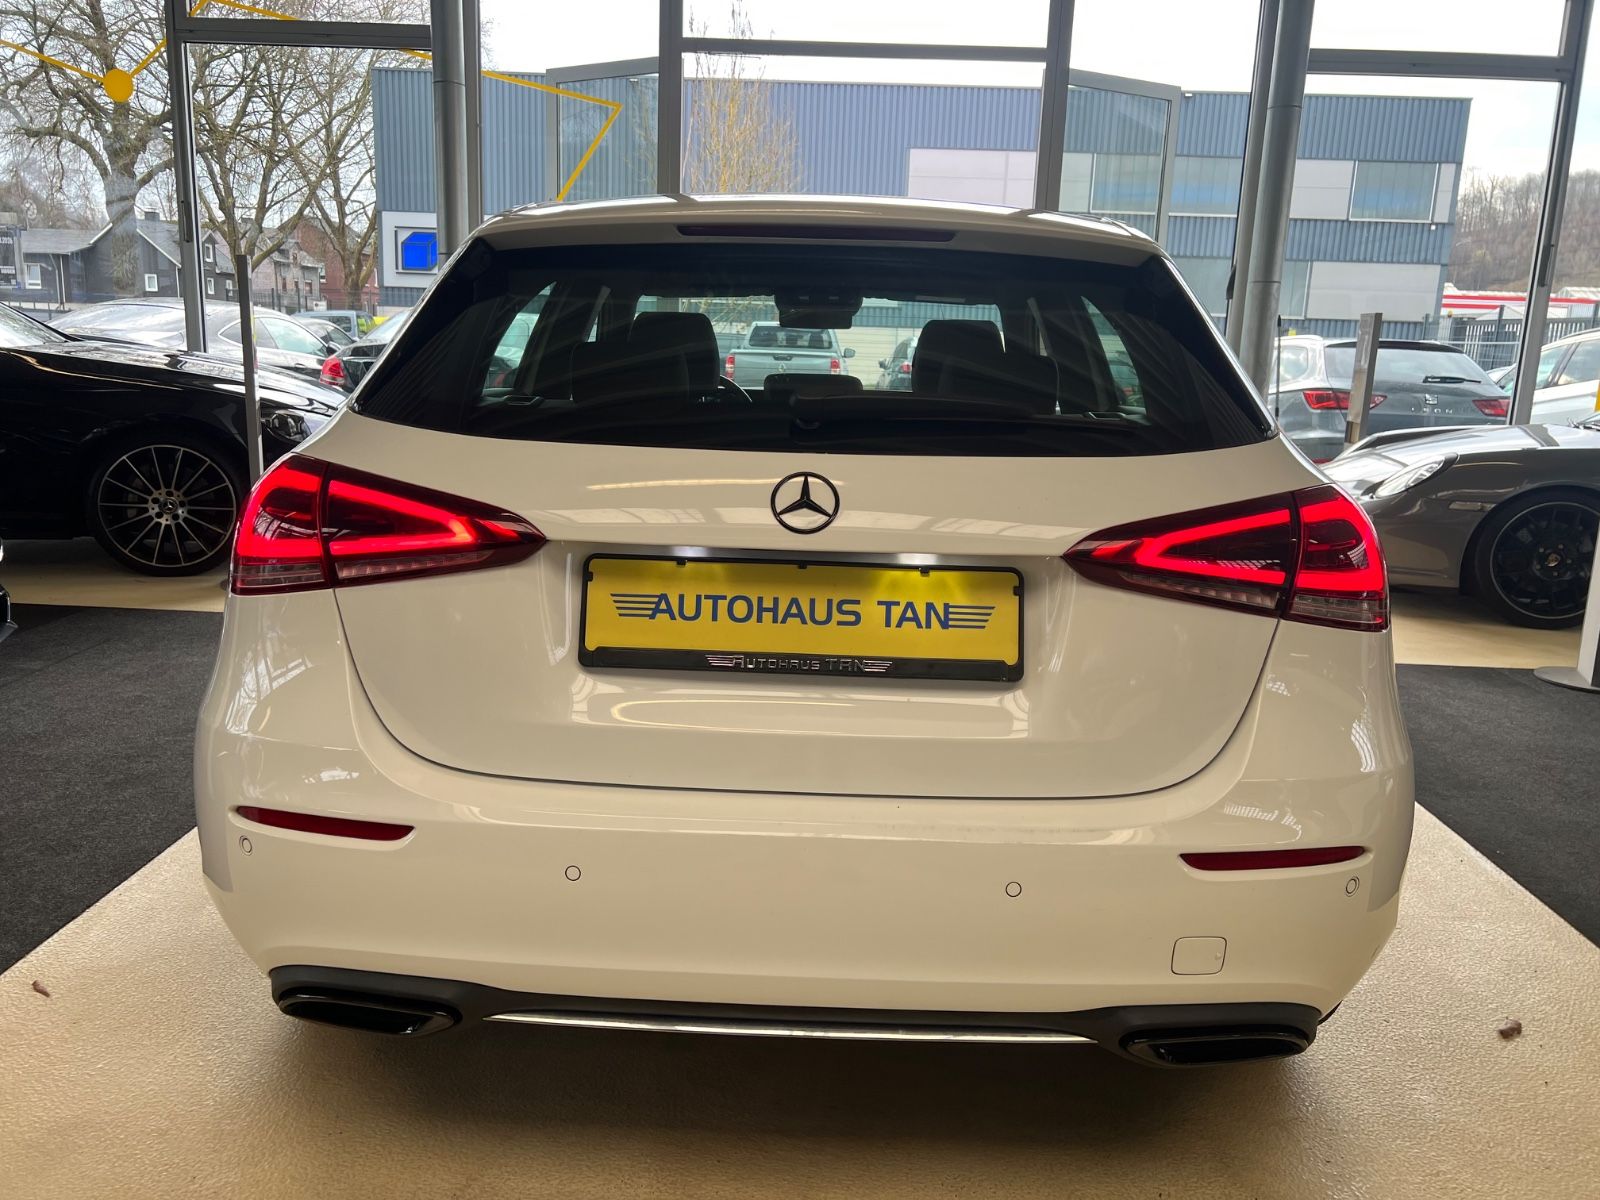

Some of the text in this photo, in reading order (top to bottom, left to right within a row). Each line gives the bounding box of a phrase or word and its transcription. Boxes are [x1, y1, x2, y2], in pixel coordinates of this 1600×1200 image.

[648, 593, 950, 630] AUTOHAUS TAN
[732, 655, 866, 673] AUTOHAUS TAN
